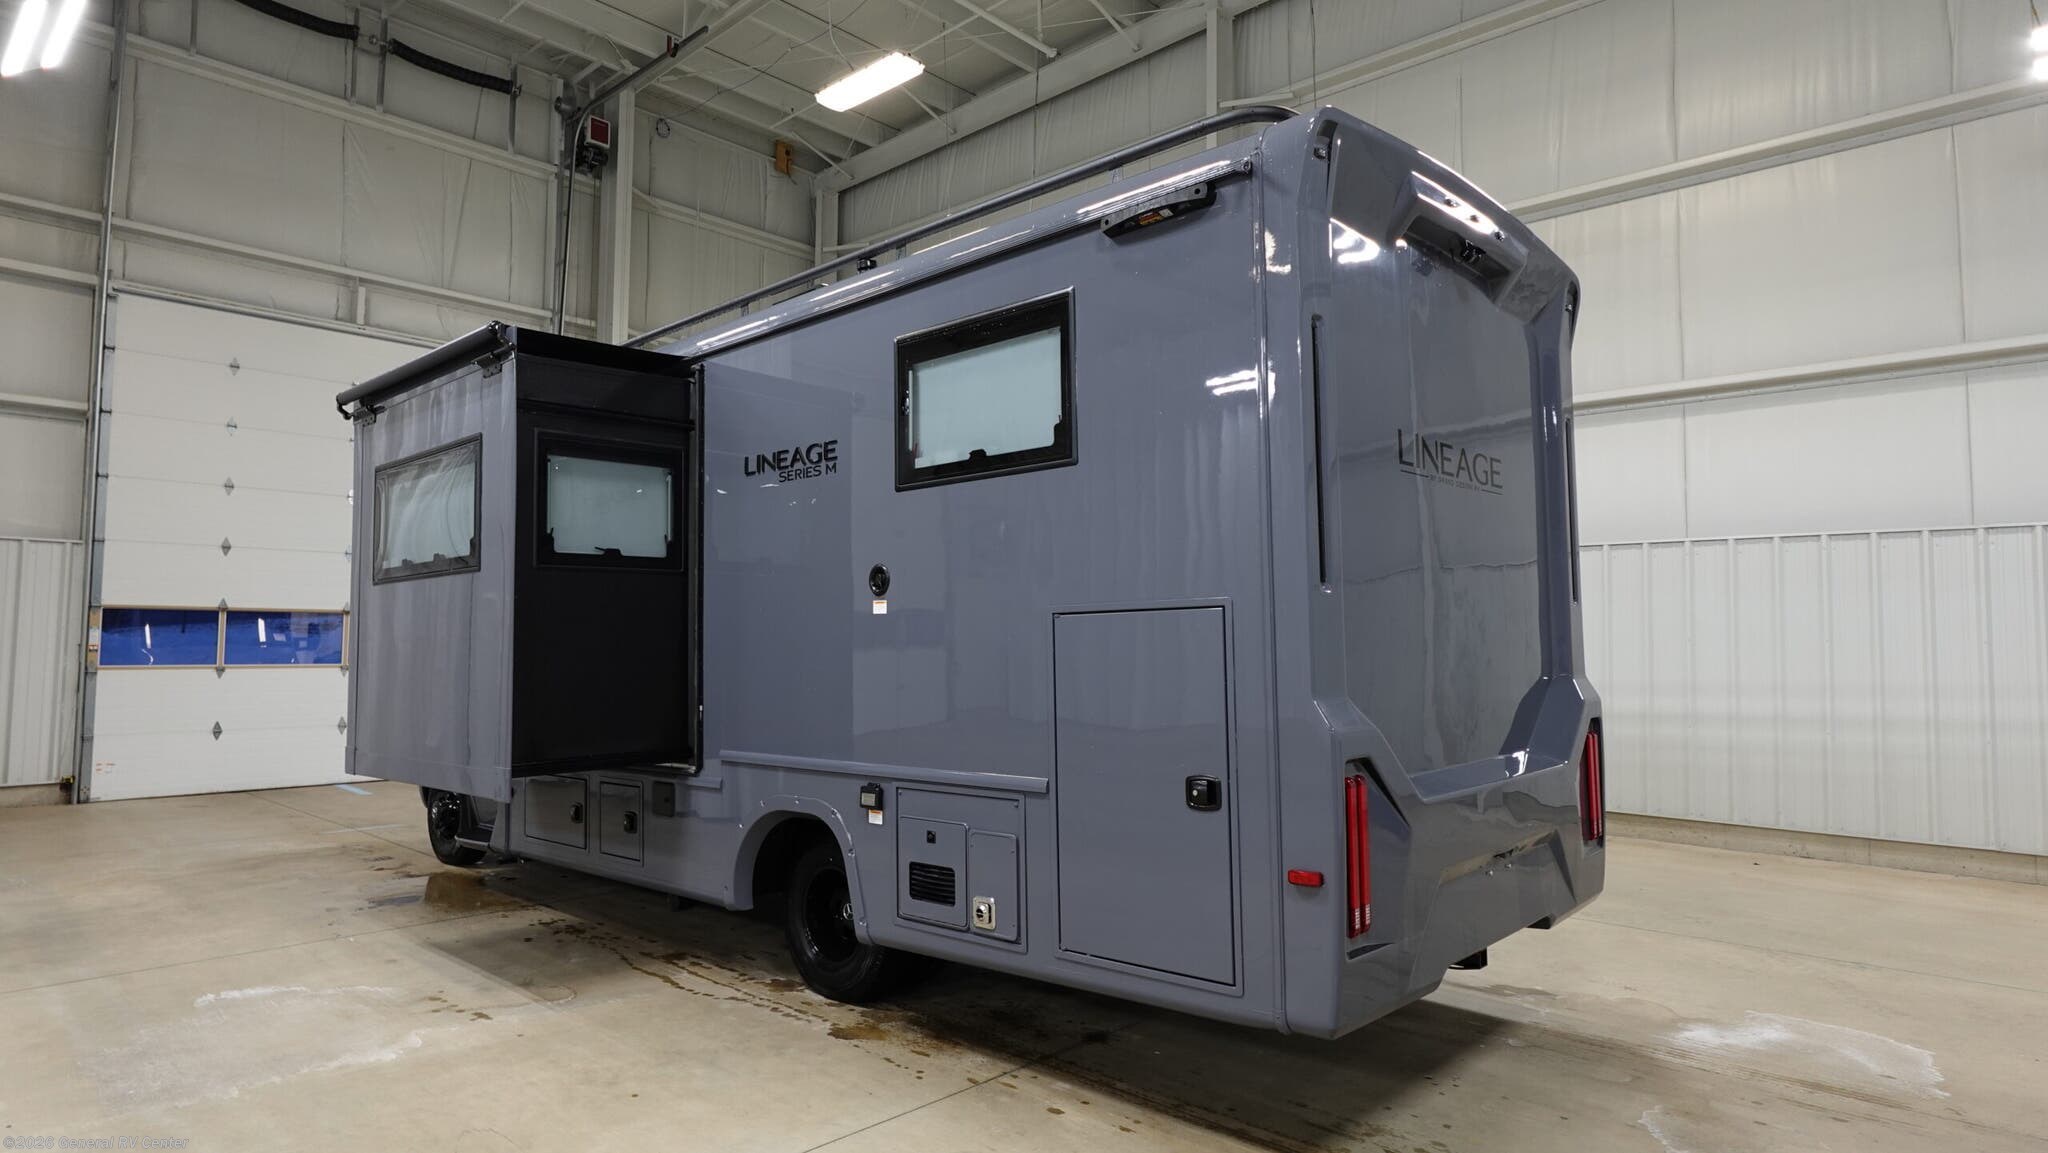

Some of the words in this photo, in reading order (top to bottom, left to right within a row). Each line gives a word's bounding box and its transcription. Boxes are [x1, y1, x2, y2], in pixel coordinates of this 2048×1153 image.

[744, 439, 838, 477] LINEAGE
[779, 465, 822, 483] SERIES
[825, 462, 837, 475] M
[1397, 428, 1503, 489] LINEAGE
